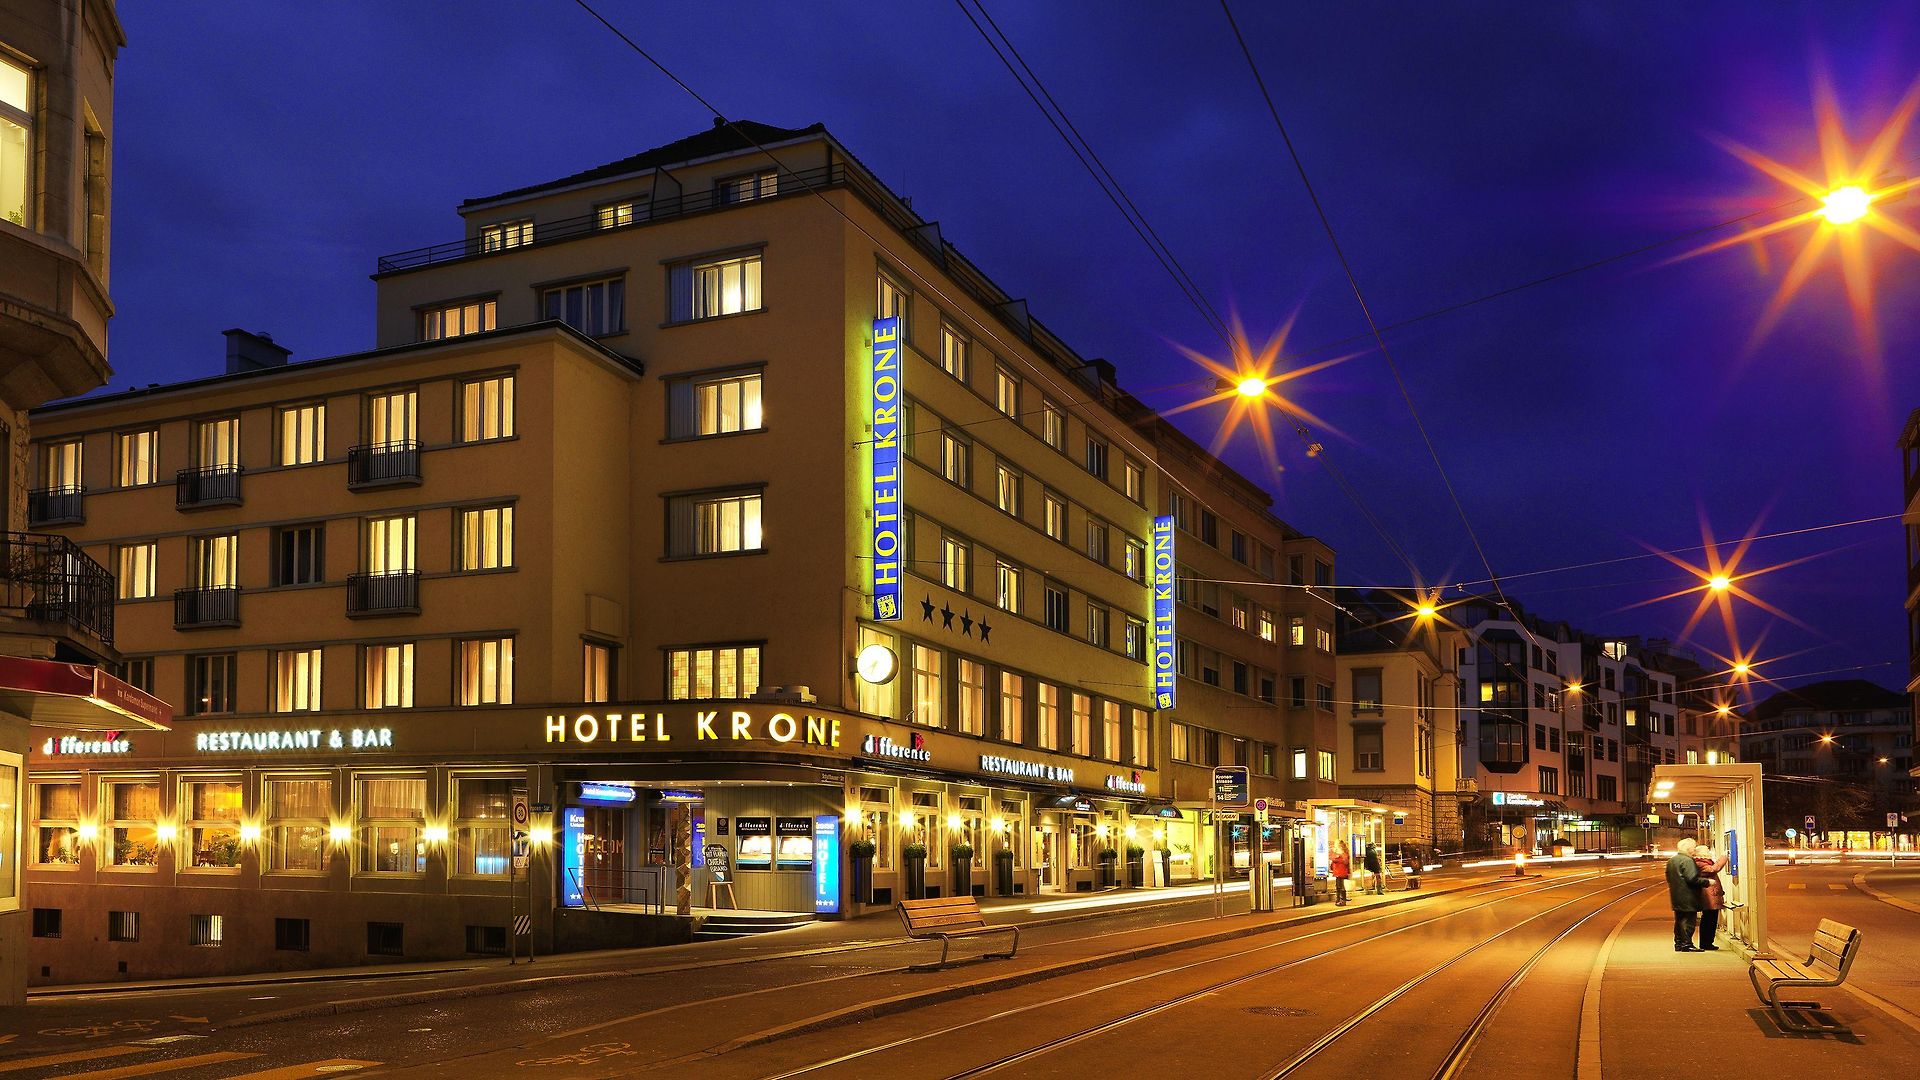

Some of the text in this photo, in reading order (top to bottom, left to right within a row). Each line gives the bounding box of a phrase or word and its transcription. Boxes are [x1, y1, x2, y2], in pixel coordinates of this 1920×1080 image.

[874, 326, 898, 585] HOTEL KRONE
[1155, 521, 1173, 687] HOTEL KRONE
[197, 728, 392, 751] RESTAURANT & BAR
[546, 711, 841, 747] HOTEL KRONE
[43, 736, 130, 754] differente
[864, 734, 931, 762] differente
[981, 755, 1074, 783] RESTAURANT & BAR
[1107, 774, 1146, 793] differente
[818, 838, 828, 895] HOTEL
